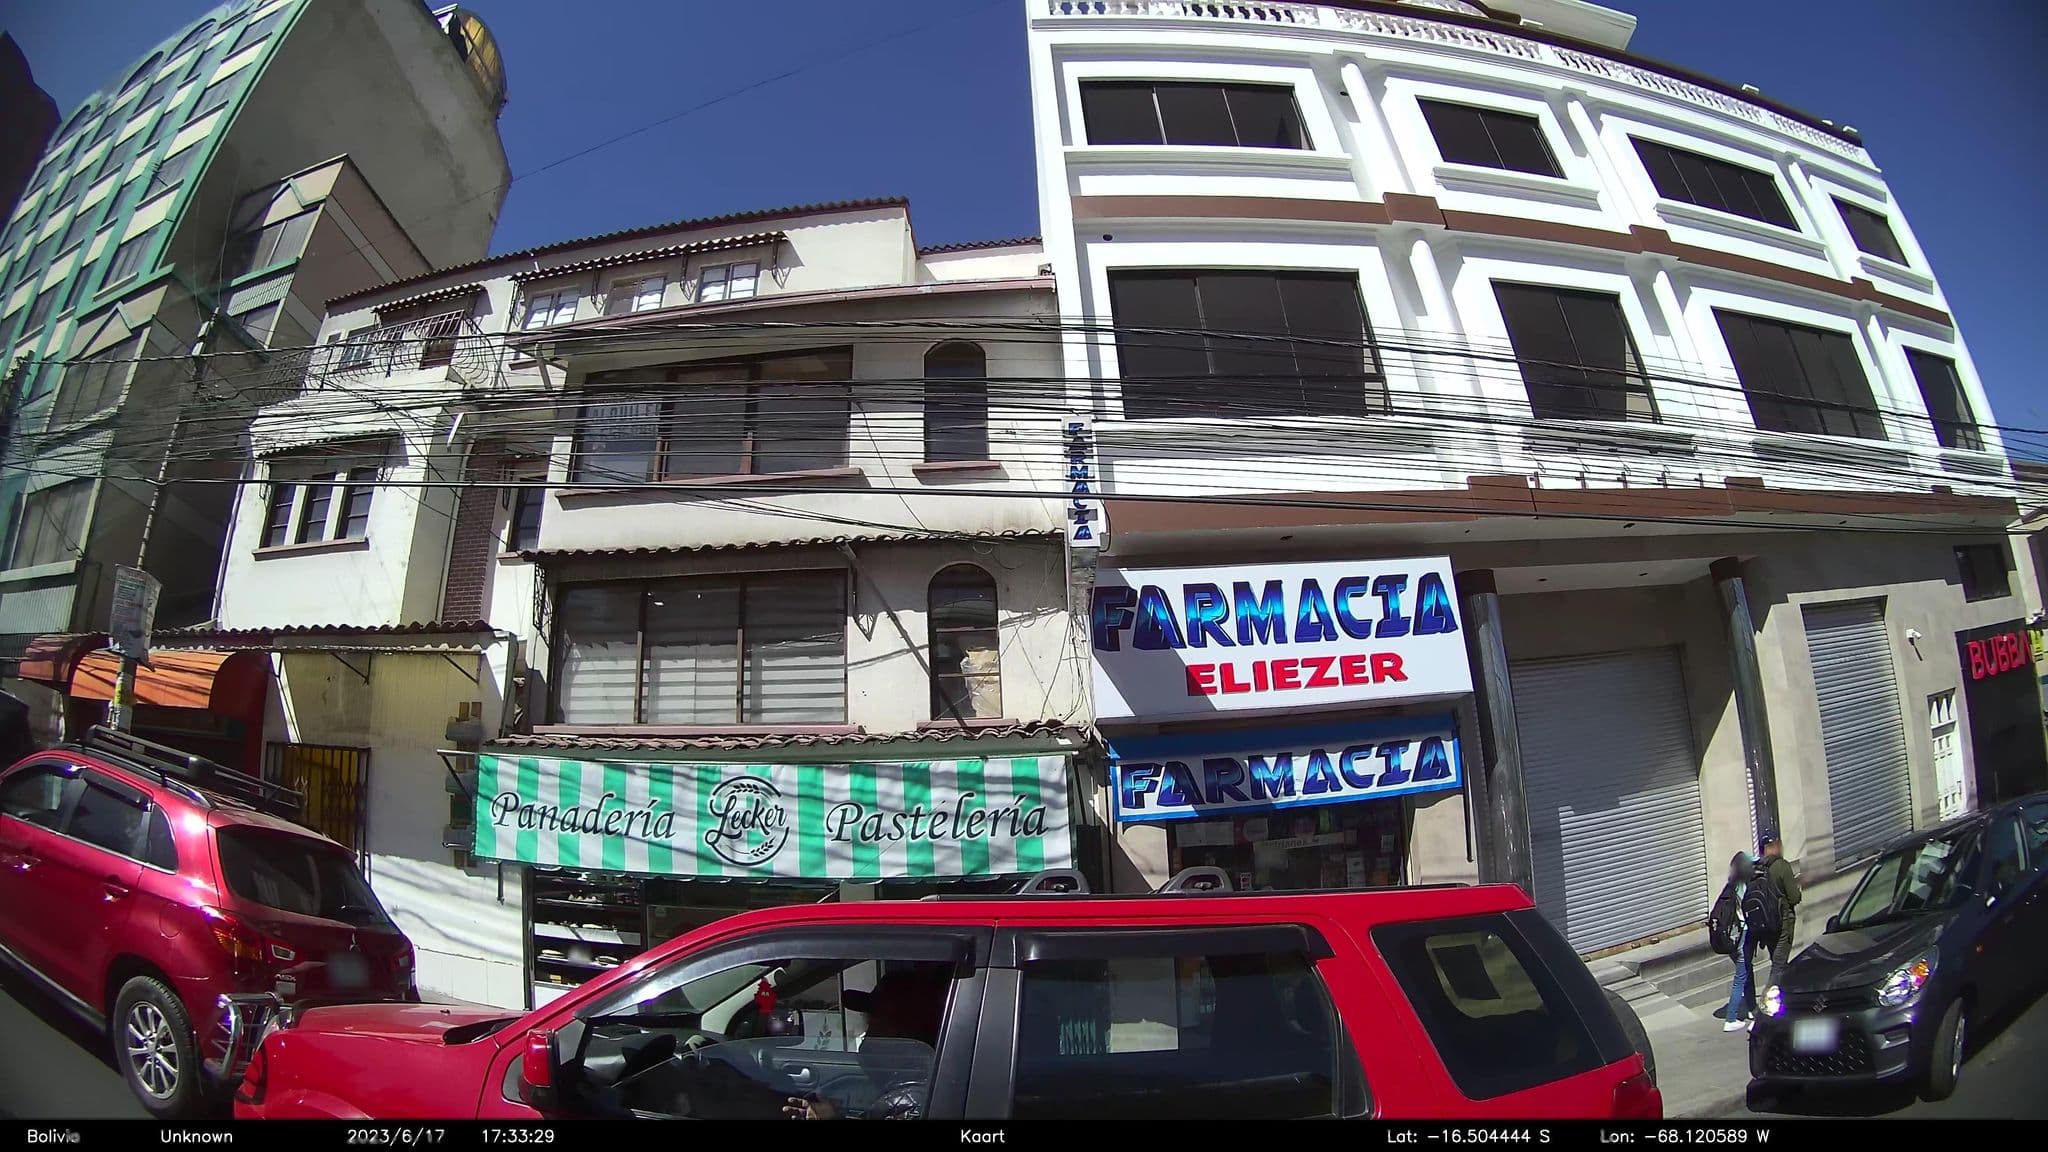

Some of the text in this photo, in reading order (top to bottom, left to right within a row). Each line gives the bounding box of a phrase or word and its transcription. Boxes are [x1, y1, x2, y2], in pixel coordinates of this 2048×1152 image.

[1068, 422, 1093, 540] FARMACIA
[1091, 572, 1459, 652] FARMACIA
[1185, 652, 1408, 696] ELIEZER
[1120, 736, 1453, 809] FARMACIA
[491, 791, 676, 839] Panadería
[705, 795, 787, 845] Lecker
[826, 792, 1049, 841] Pastelería
